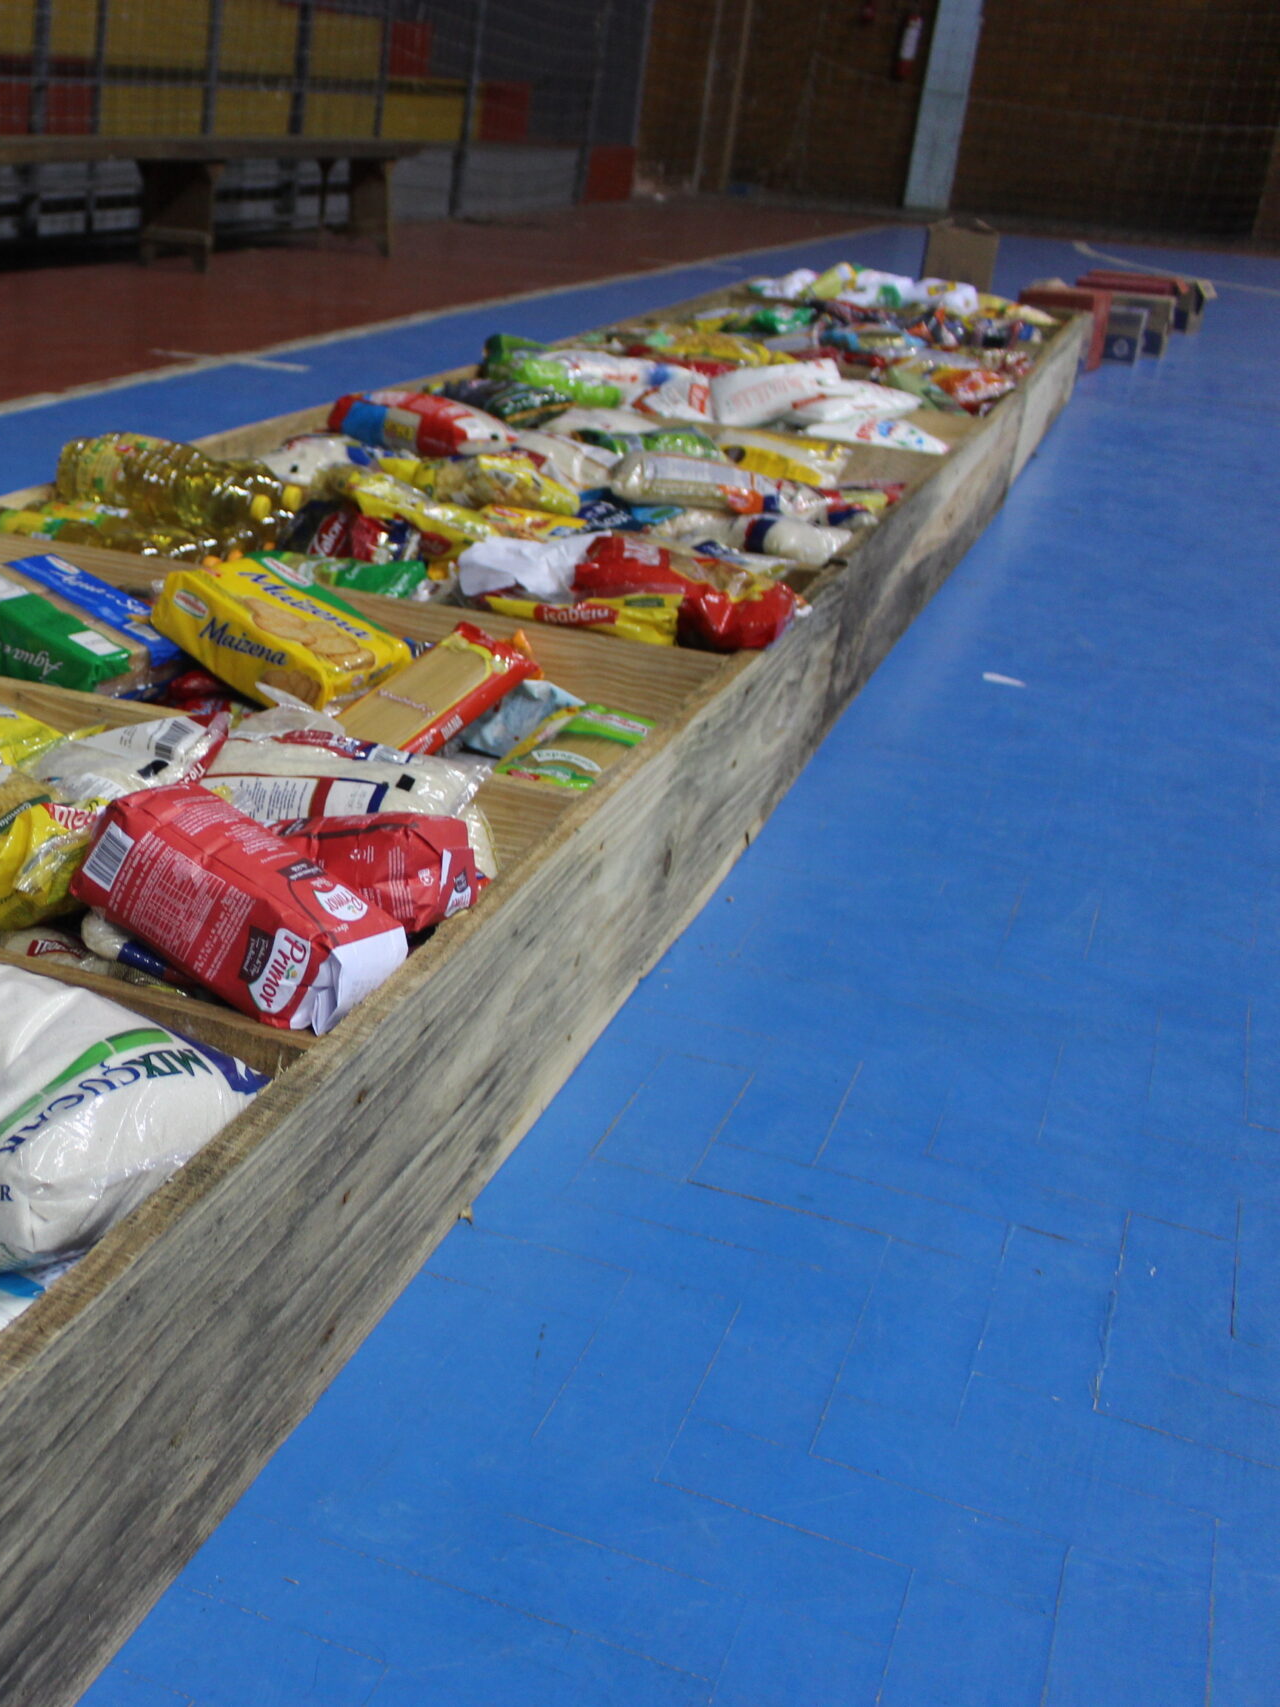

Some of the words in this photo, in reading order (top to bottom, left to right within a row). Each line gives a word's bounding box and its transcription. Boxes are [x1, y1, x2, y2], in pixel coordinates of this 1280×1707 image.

[237, 571, 372, 640] Maizena
[198, 617, 288, 666] Maizena
[260, 936, 306, 1008] Primor
